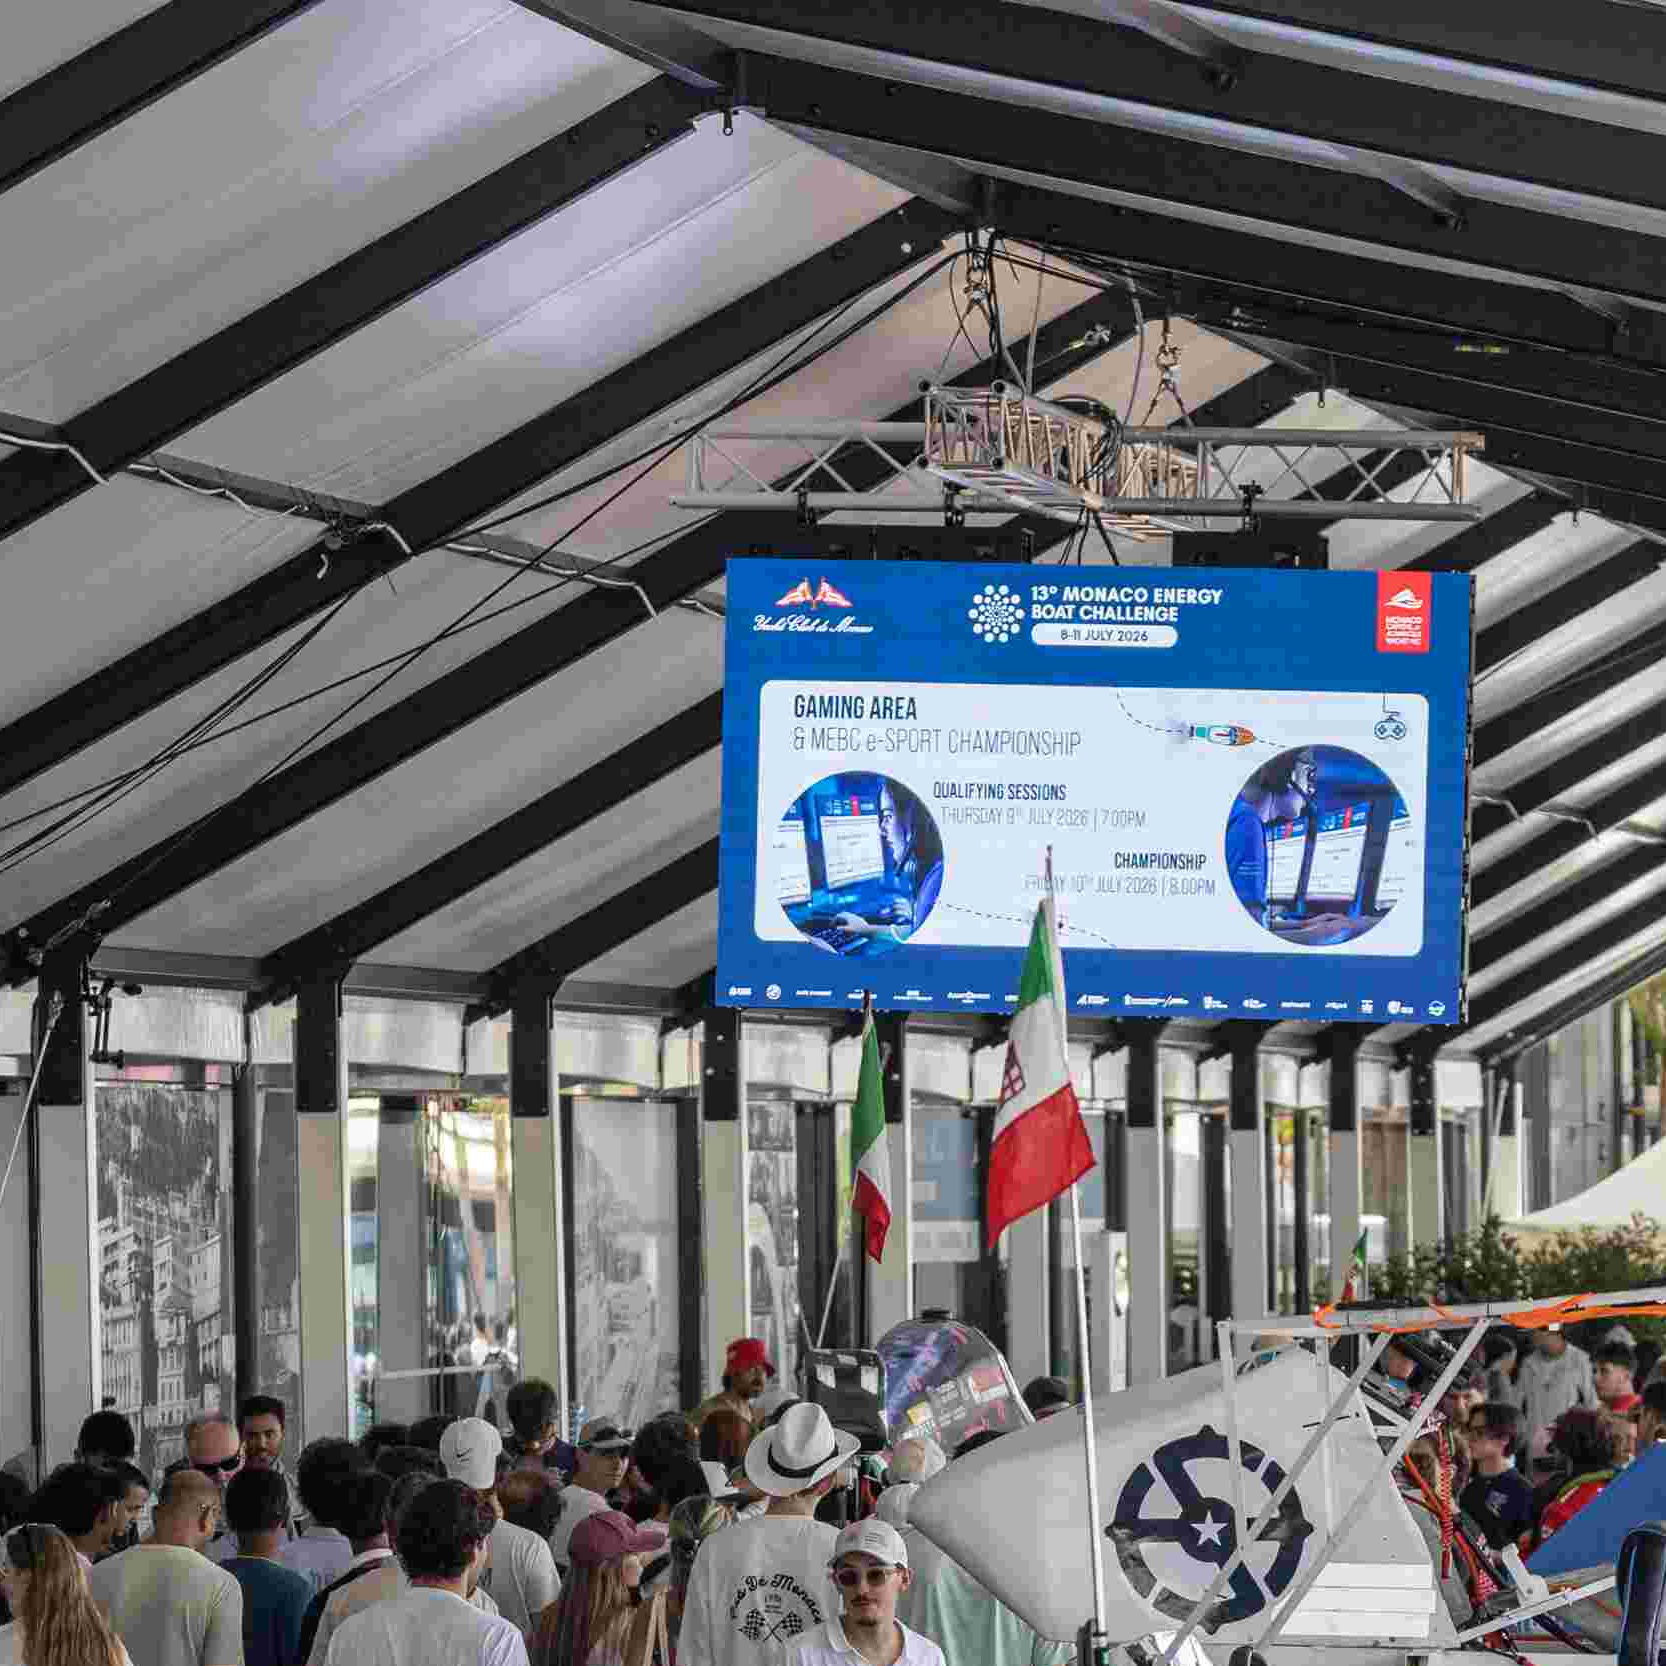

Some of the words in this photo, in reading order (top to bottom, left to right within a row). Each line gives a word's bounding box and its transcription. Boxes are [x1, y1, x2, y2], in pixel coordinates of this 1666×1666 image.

[1062, 587, 1149, 604] MONACO
[1152, 588, 1223, 606] ENERGY
[1031, 604, 1077, 621] BOAT
[1080, 606, 1180, 623] CHALLENGE
[1085, 630, 1114, 643] JULY
[1117, 630, 1149, 643] 2026
[793, 694, 865, 720] GAMING
[869, 696, 918, 721] AREA
[793, 726, 806, 751] &
[810, 726, 861, 752] MEBC
[865, 728, 942, 754] e-SPORT
[947, 729, 1083, 757] CHAMPIONSHIP
[933, 781, 1005, 801] QUALIFYING
[1007, 783, 1067, 801] SESSIONS
[940, 805, 1004, 825] THURSDAY
[1027, 807, 1054, 826] JULY
[1055, 808, 1088, 827] 2026
[1114, 851, 1207, 870] CHAMPIONSHIP
[1124, 876, 1157, 895] 2026
